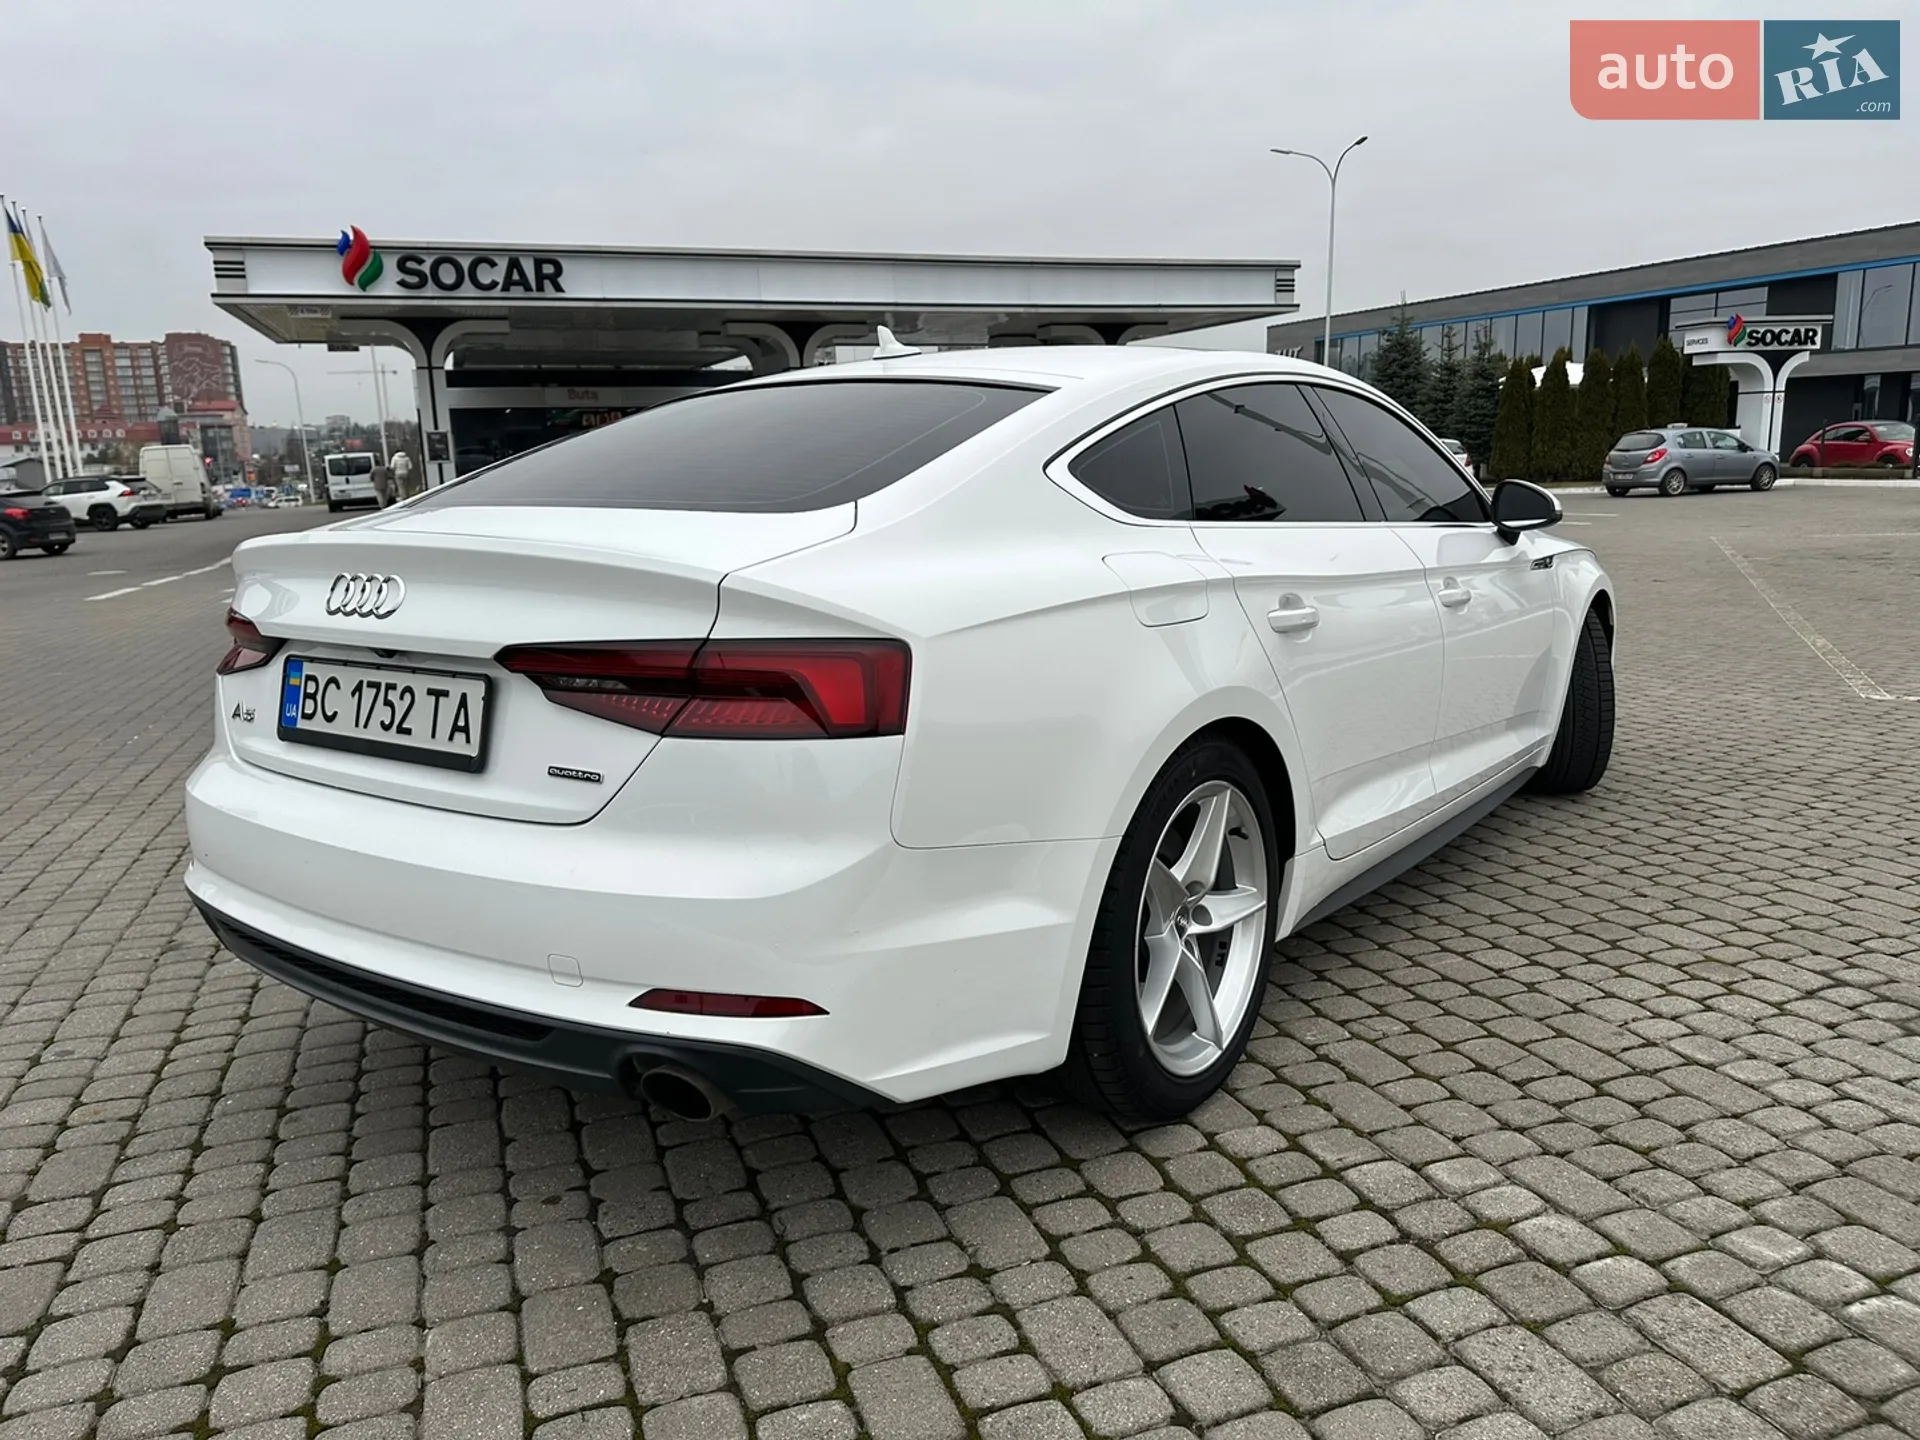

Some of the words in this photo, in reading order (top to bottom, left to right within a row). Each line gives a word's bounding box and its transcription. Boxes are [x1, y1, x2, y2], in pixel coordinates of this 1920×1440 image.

[396, 254, 565, 293] SOCAR
[1746, 328, 1818, 347] SOCAR
[284, 703, 298, 719] UA
[301, 674, 341, 723] BC
[350, 679, 417, 737] 1752
[426, 688, 472, 744] TA
[548, 767, 600, 781] quattro
